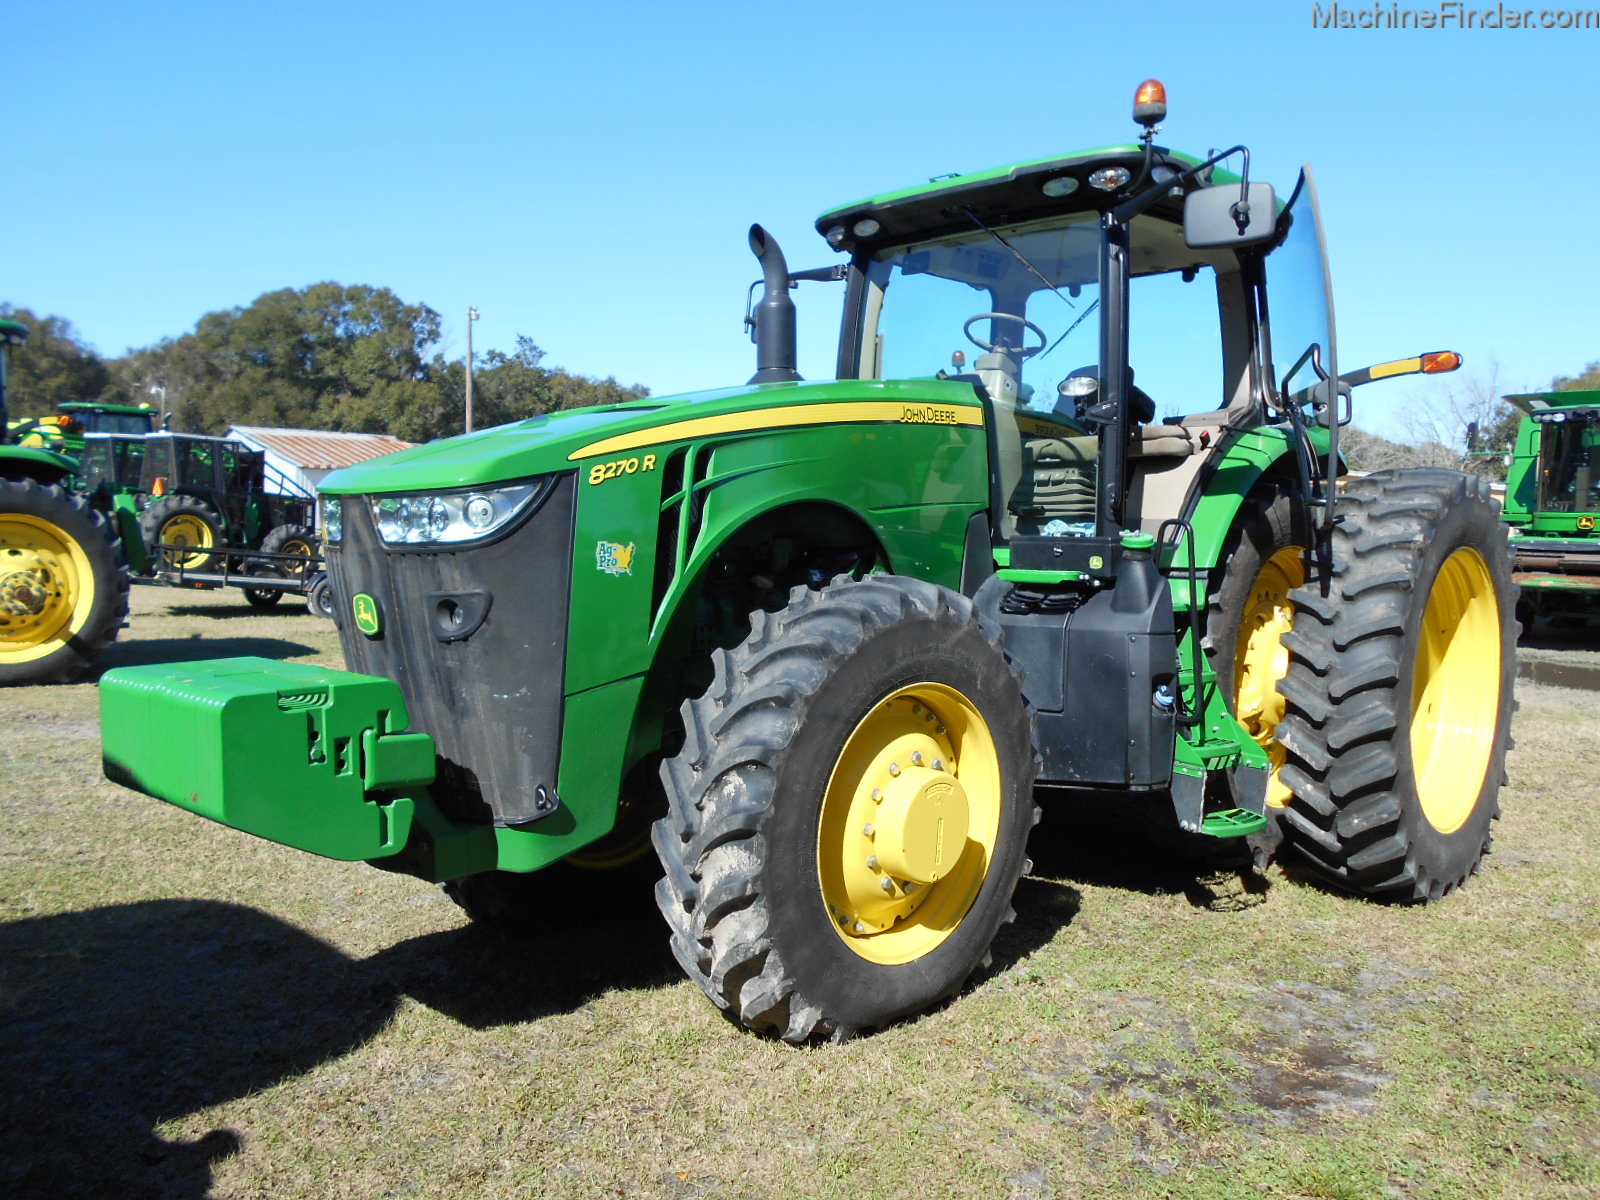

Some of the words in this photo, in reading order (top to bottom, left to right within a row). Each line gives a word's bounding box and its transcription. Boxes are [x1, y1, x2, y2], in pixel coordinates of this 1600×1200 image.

[900, 406, 926, 421] JOHN
[926, 407, 956, 423] DEERE
[588, 457, 640, 486] 8270
[641, 454, 656, 472] R
[600, 556, 618, 567] Pro
